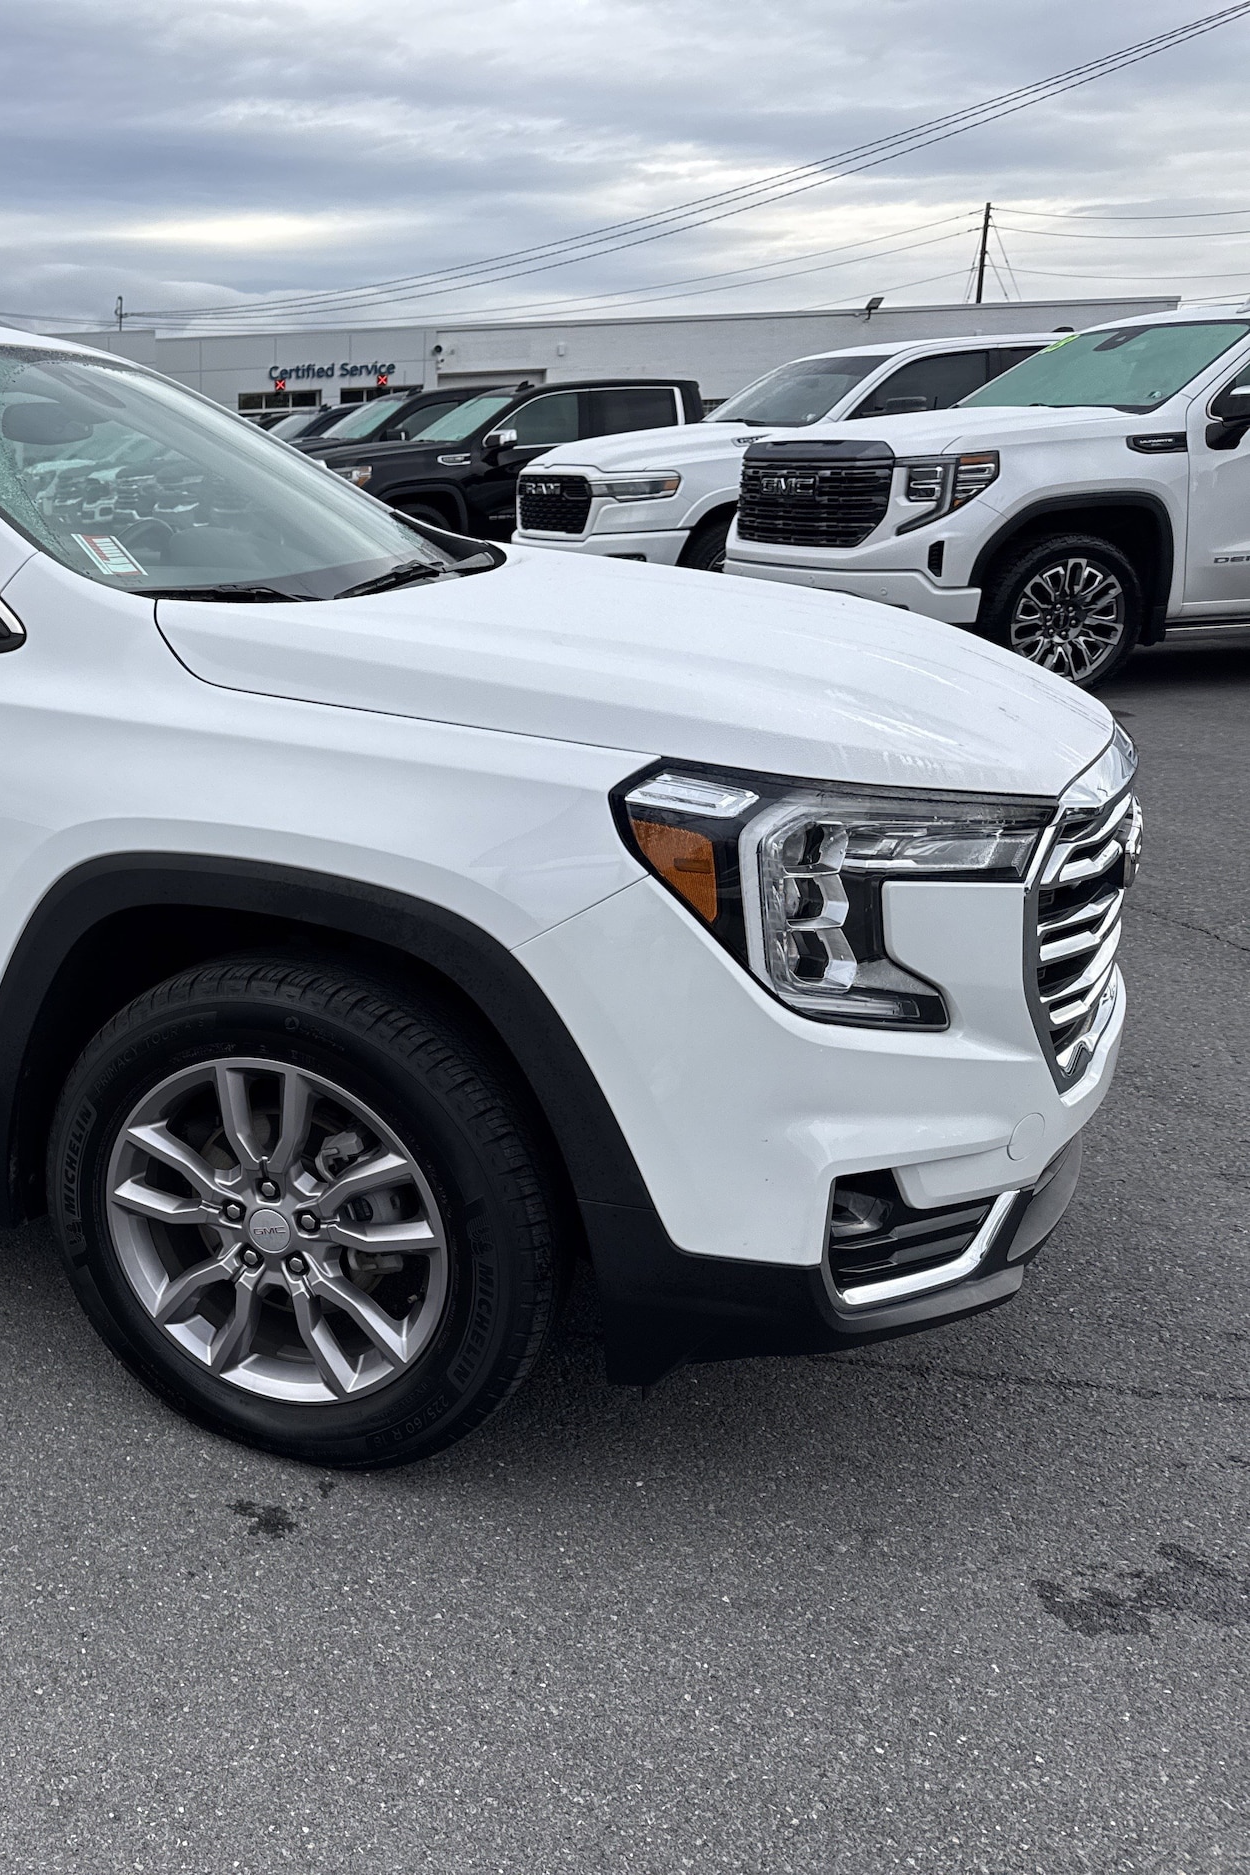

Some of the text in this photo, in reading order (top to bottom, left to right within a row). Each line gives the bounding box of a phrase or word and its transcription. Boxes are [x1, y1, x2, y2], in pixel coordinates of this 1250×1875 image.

[268, 361, 396, 380] Certified Service
[525, 482, 561, 495] RAM
[761, 477, 815, 496] GMC
[63, 1104, 93, 1215] MICHELIN
[93, 1045, 139, 1092] PRIMACY
[144, 1025, 180, 1049] TOUR
[253, 1226, 287, 1236] GMC
[452, 1262, 494, 1385] MICHELIN
[405, 1395, 449, 1434] 225/60
[391, 1429, 403, 1441] R
